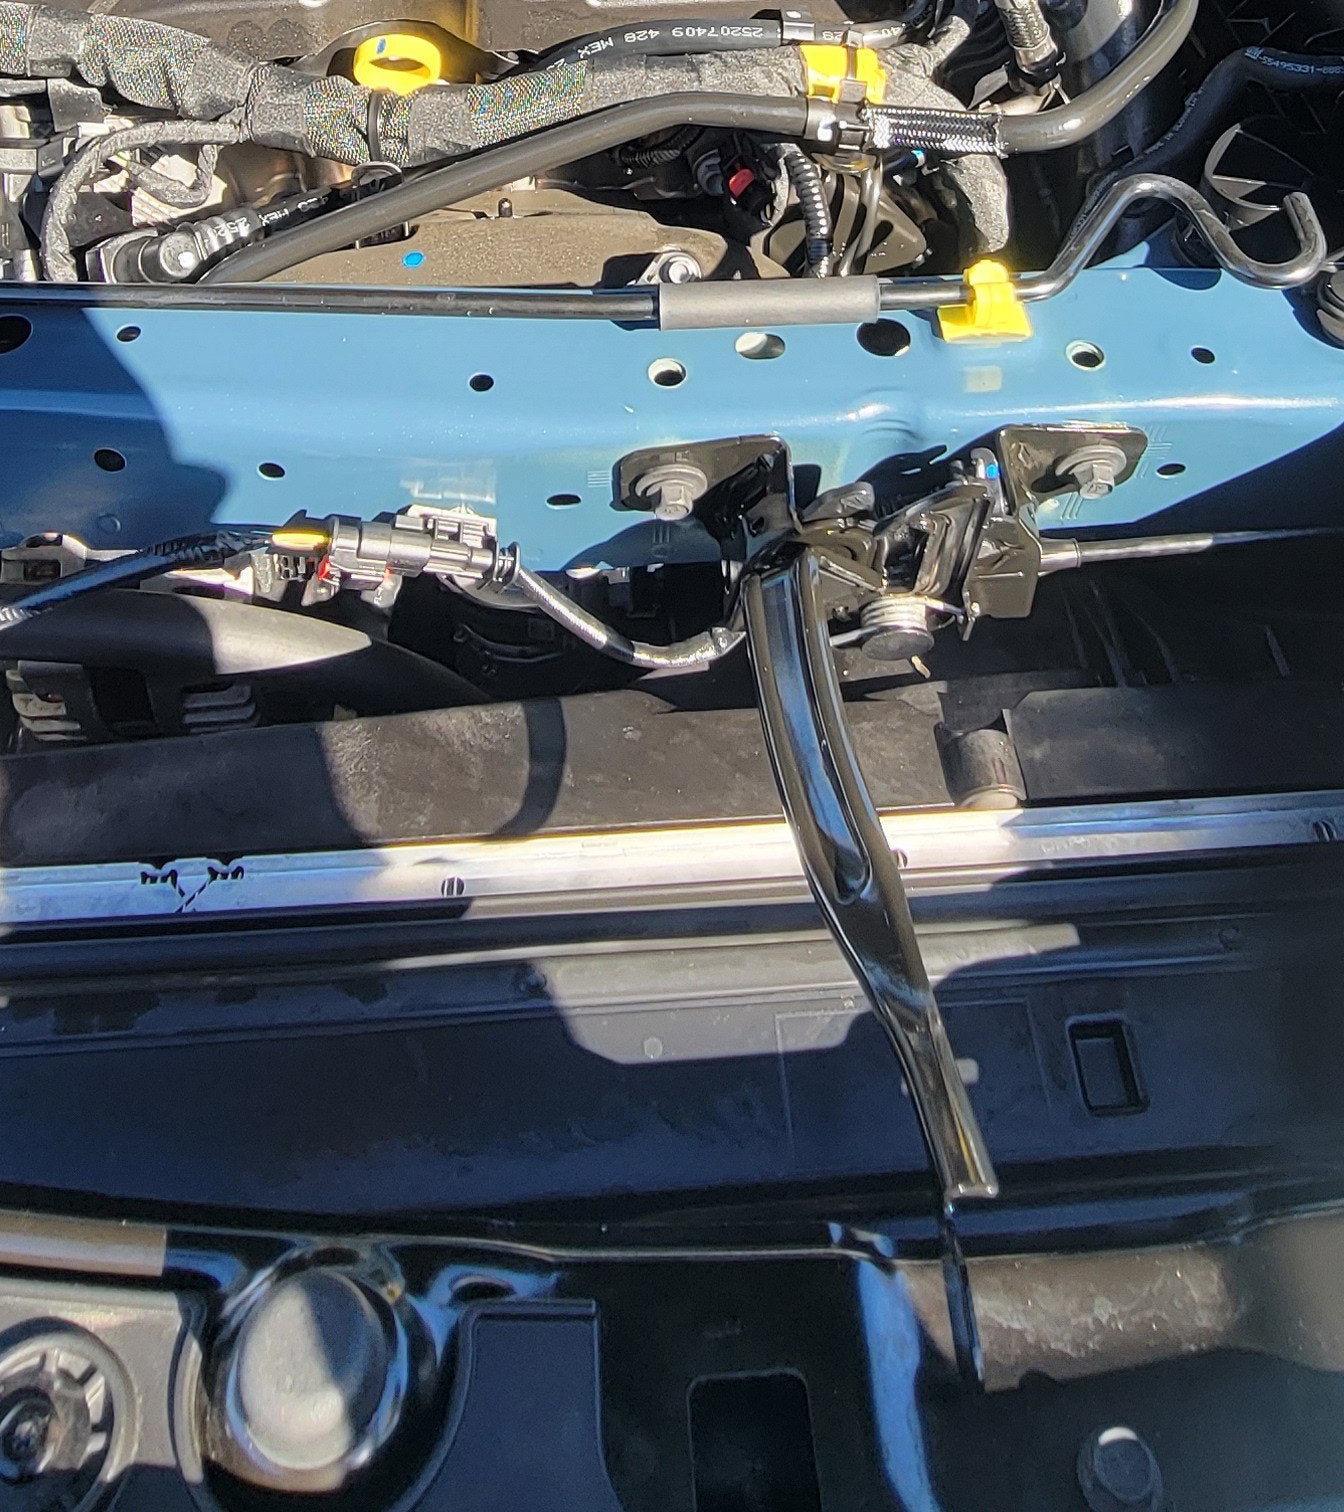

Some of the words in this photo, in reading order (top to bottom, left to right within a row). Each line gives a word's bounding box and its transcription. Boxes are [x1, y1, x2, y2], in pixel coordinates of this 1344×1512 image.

[623, 28, 660, 44] 428
[671, 26, 764, 38] 25207409
[577, 36, 615, 60] MEX
